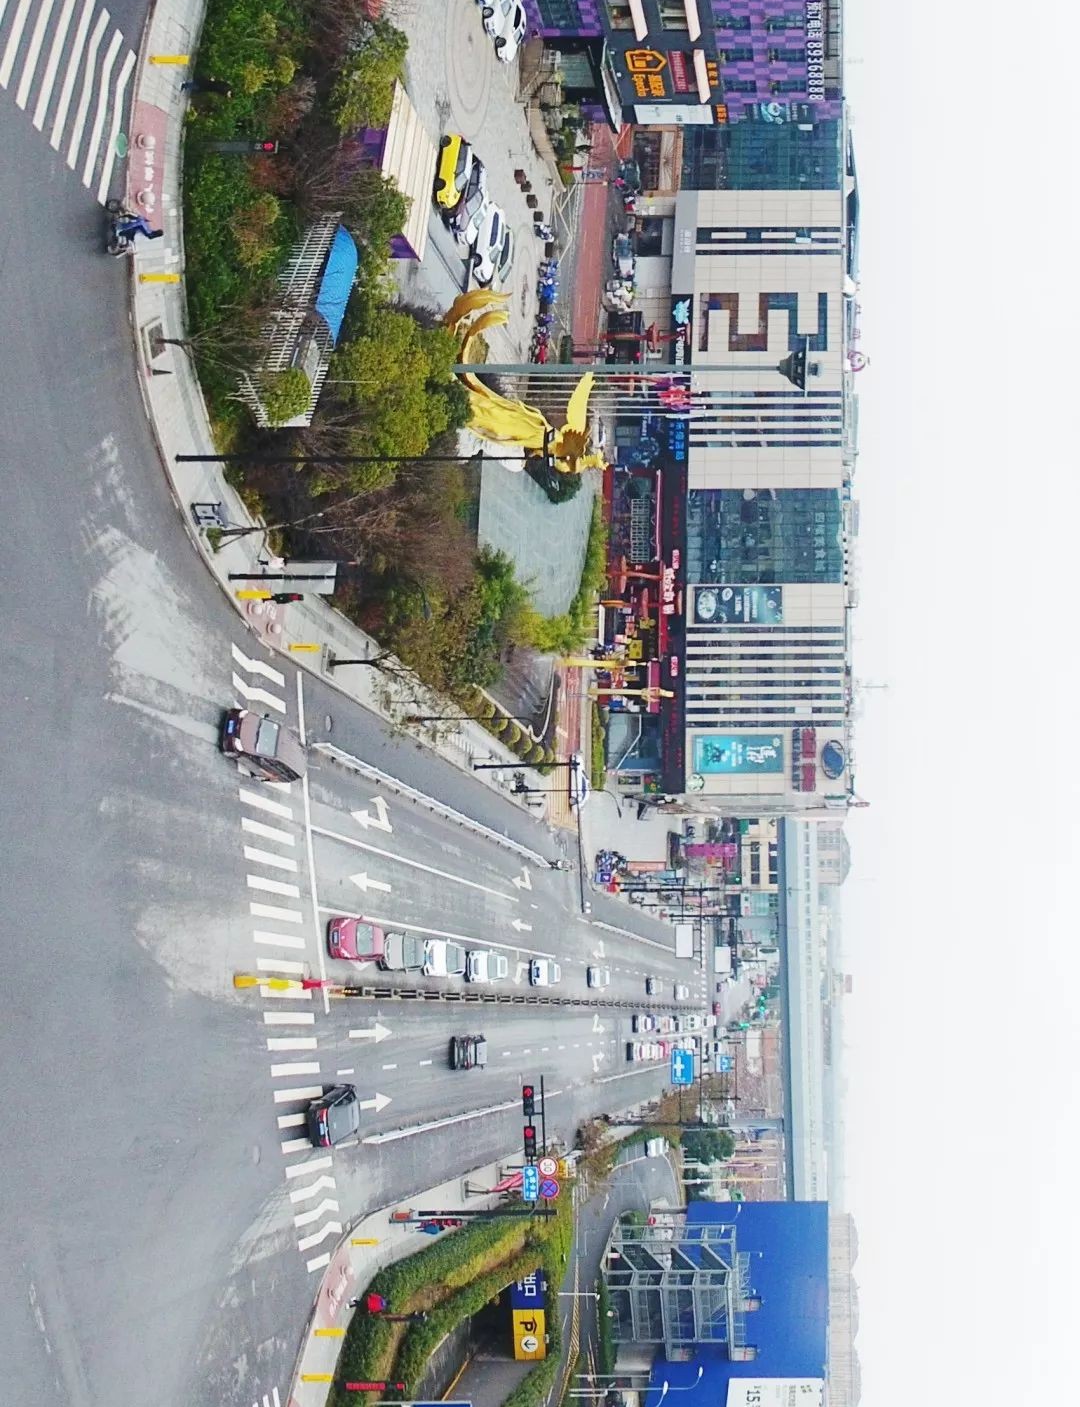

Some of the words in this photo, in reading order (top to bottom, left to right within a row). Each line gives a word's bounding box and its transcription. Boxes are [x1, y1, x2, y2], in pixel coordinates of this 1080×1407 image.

[806, 1, 822, 38] 预订电话
[807, 42, 824, 101] 89368888
[524, 1272, 536, 1296] 出口
